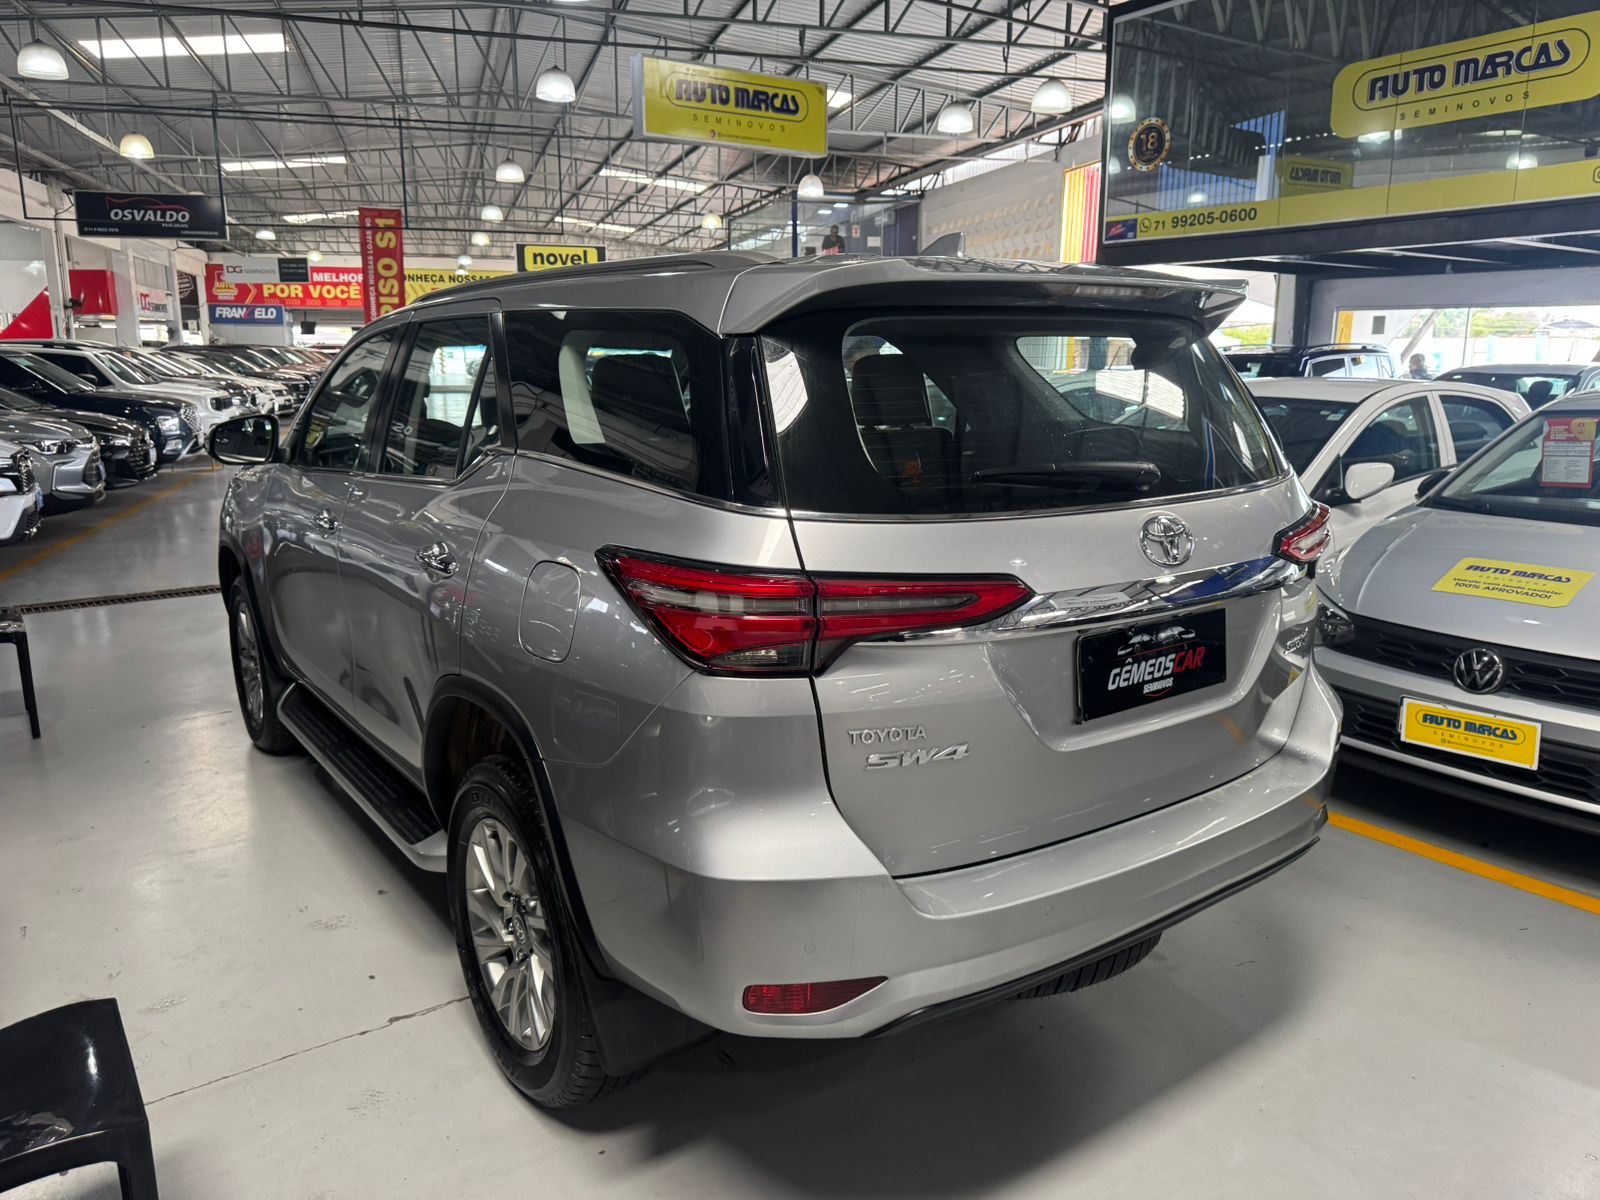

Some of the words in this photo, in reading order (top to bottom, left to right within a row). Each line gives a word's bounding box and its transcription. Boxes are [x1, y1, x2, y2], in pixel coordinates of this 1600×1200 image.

[1367, 63, 1447, 103] AUTO
[1452, 38, 1571, 87] MARCAS
[675, 78, 730, 106] AUTO
[734, 86, 801, 116] MARCAS
[1400, 91, 1531, 120] SEMINOVOS
[692, 113, 786, 132] SEMINOVOS
[110, 208, 190, 222] OSVALDO
[1153, 220, 1166, 230] 71
[1171, 207, 1258, 229] 99205-0600
[375, 218, 397, 249] S1
[533, 249, 588, 265] novel
[262, 284, 304, 298] POR
[308, 282, 361, 299] VOCÊ
[1465, 564, 1511, 575] AUTO
[1511, 570, 1572, 583] MARCAS
[849, 726, 927, 745] TOYOTA
[1422, 713, 1461, 729] AUTO
[1464, 721, 1518, 740] MARCAS
[864, 742, 969, 770] SW4
